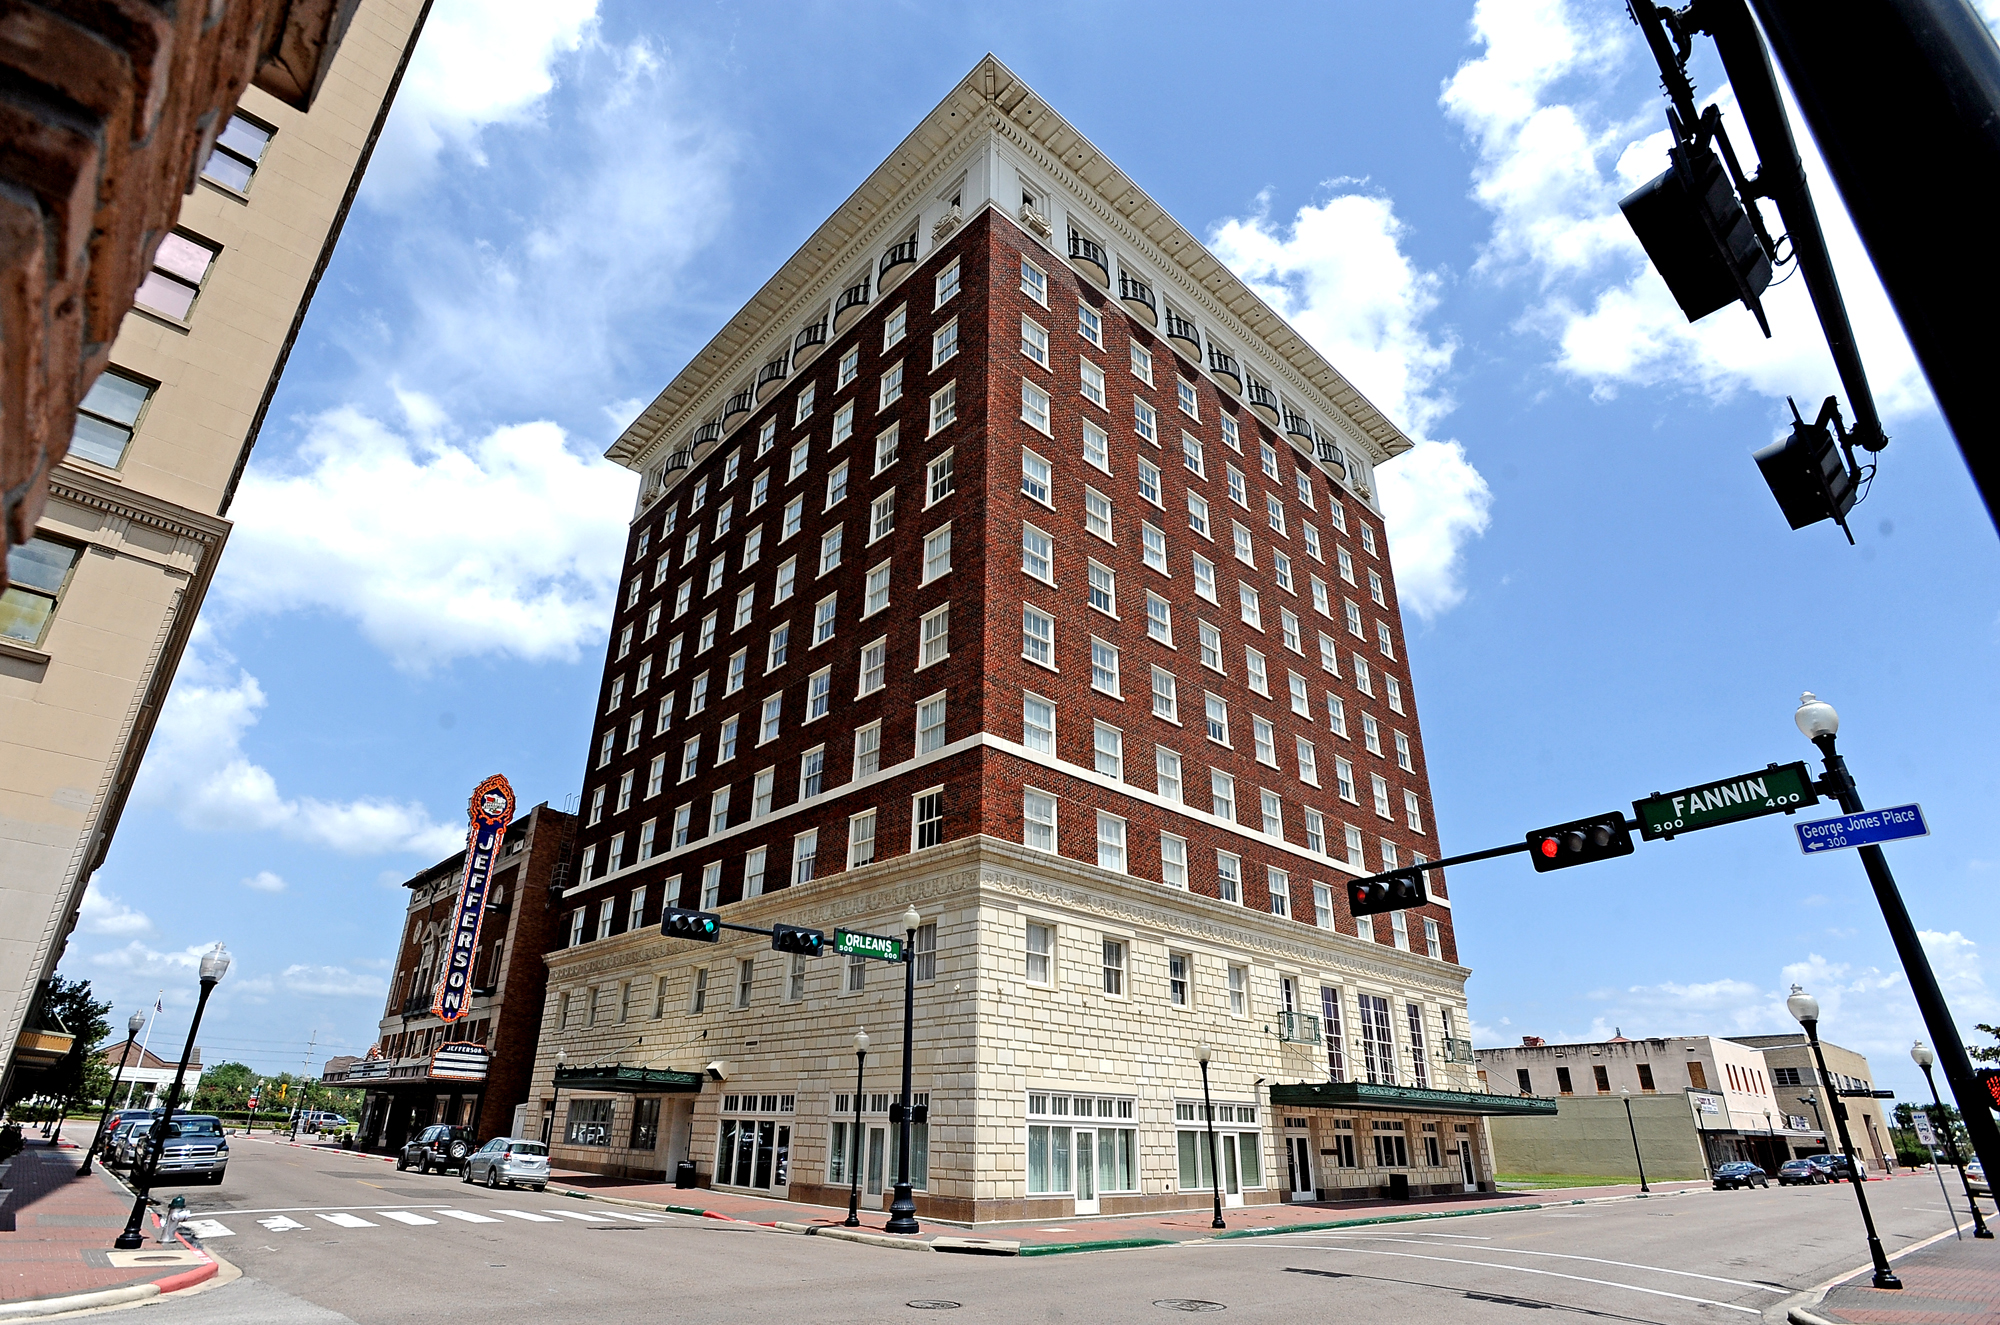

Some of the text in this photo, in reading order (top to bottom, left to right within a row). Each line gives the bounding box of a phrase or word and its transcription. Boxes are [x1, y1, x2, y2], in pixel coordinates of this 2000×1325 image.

[1672, 777, 1769, 817] FANNIN
[1653, 793, 1800, 833] 300 400
[1802, 810, 1915, 838] George Jones Place
[1827, 836, 1848, 848] 300
[444, 834, 494, 1010] JEFFERSON
[845, 933, 892, 952] ORLEANS
[446, 1045, 482, 1054] JEFFERSON
